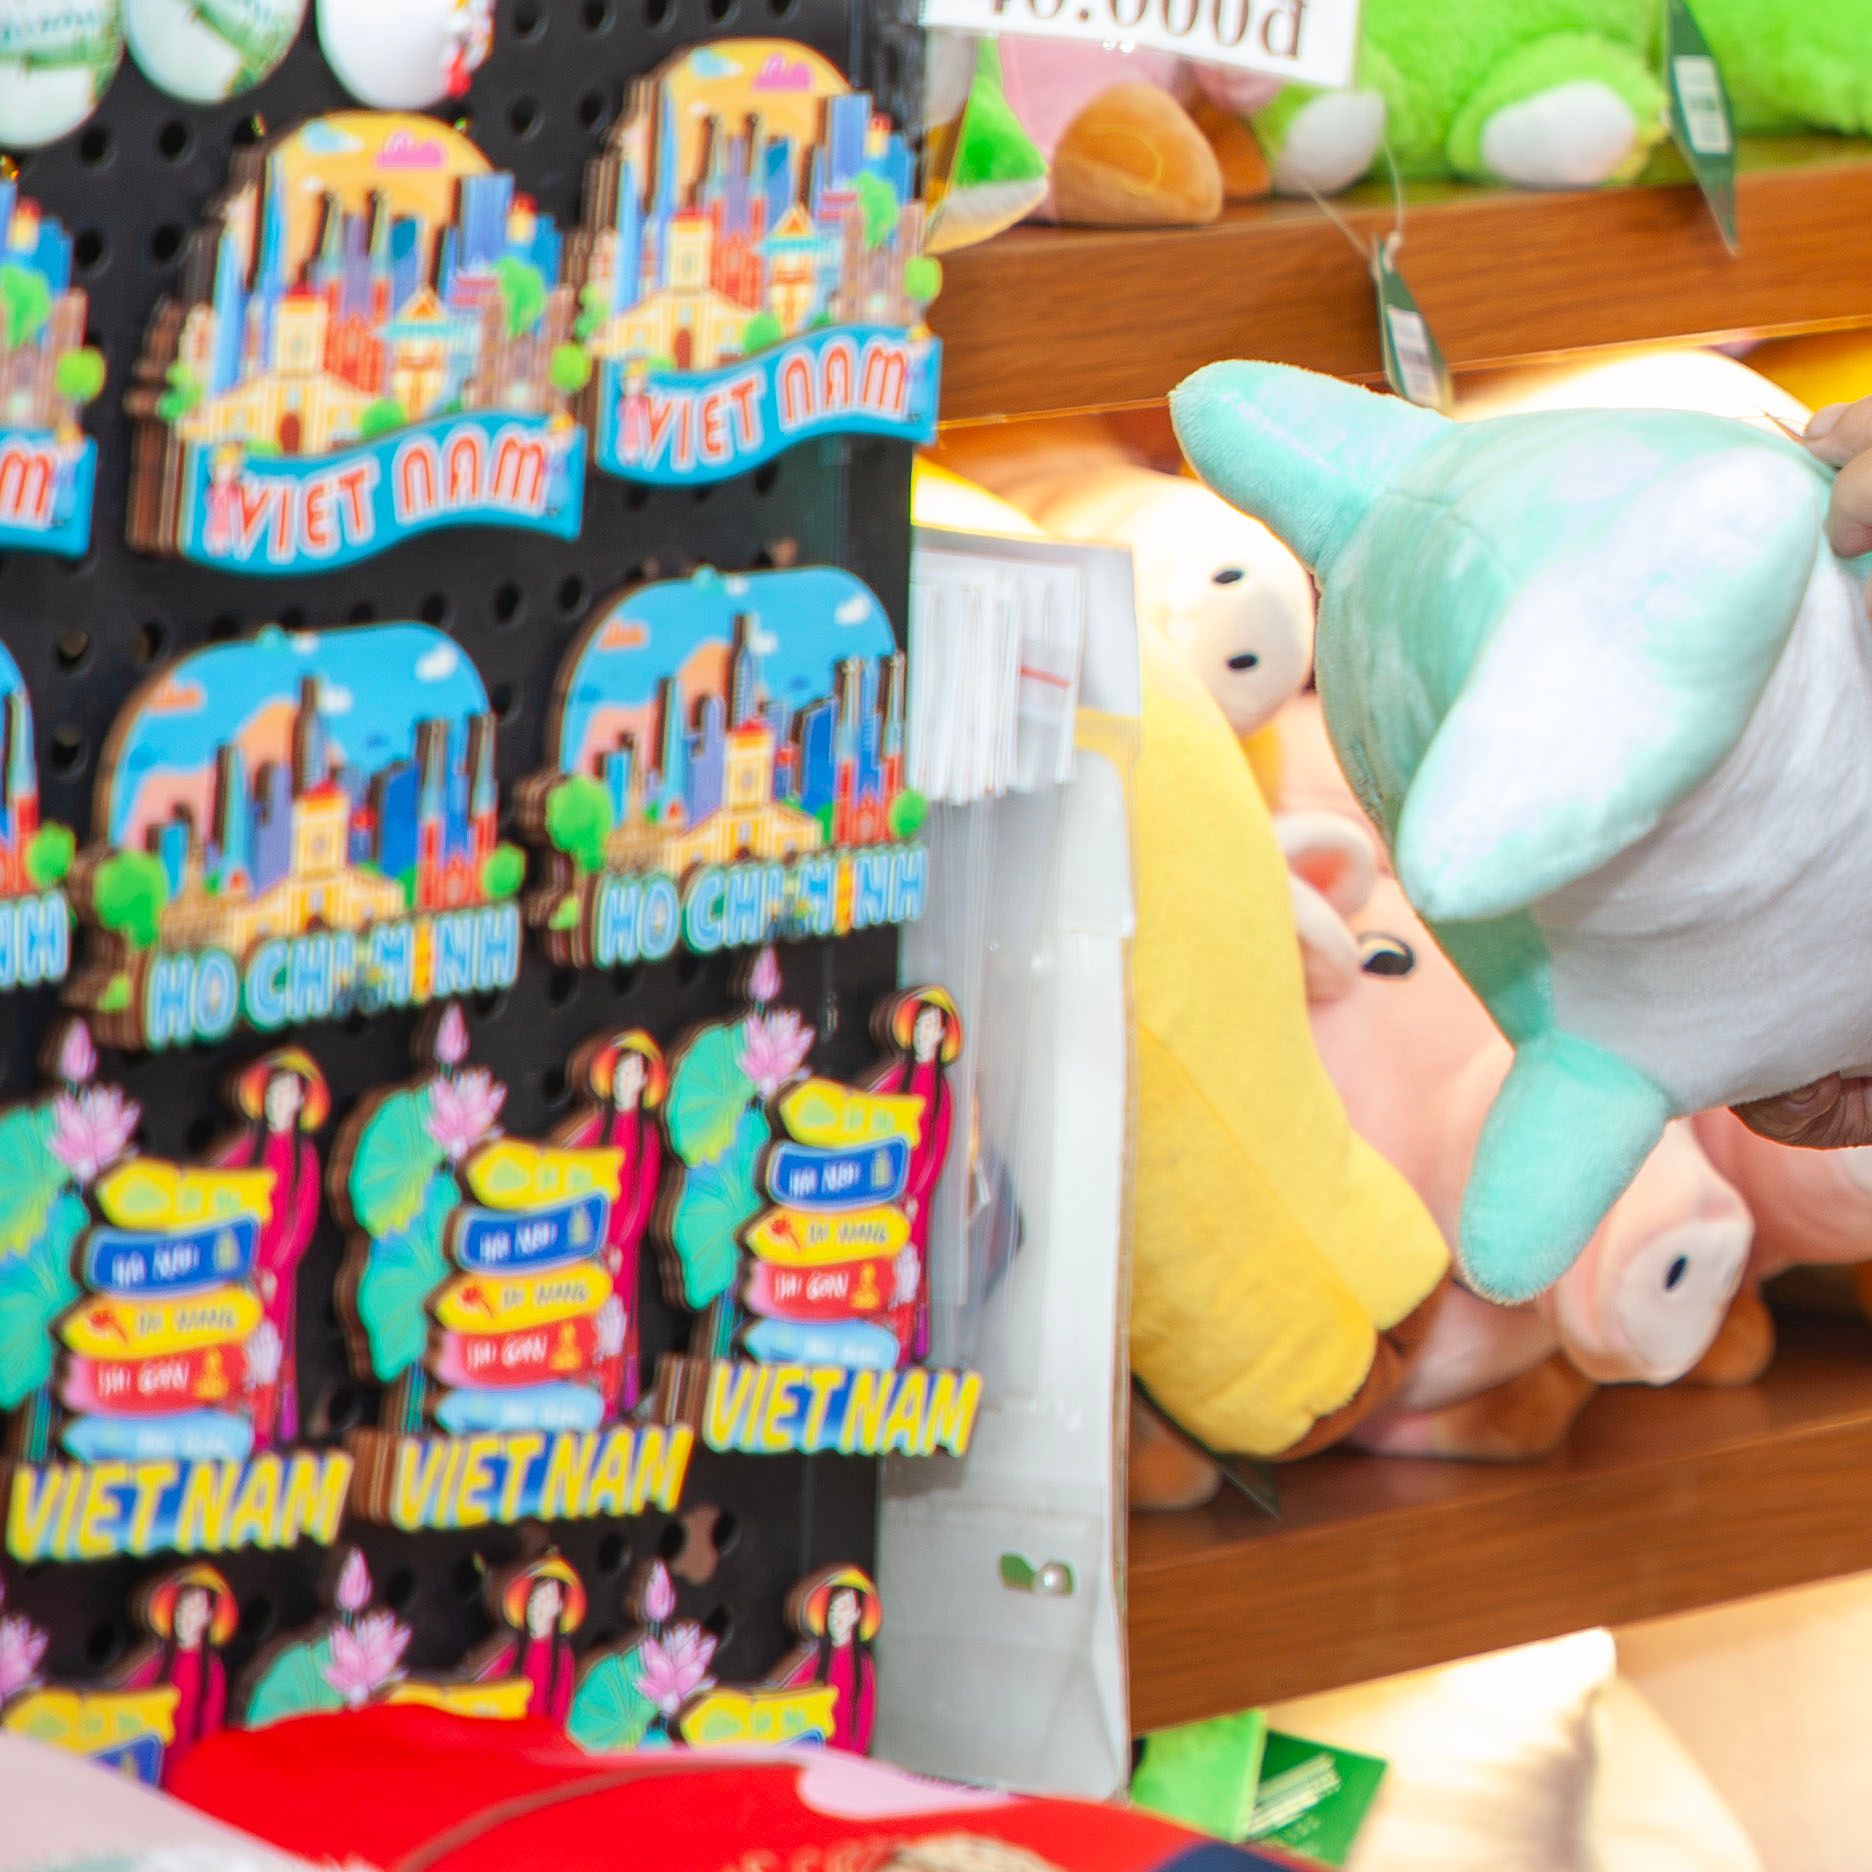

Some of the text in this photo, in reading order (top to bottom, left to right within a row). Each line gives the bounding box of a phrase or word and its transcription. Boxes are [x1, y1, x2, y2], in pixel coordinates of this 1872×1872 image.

[595, 870, 679, 970] HO
[146, 948, 240, 1052] HO
[704, 1360, 982, 1457] VIET NAM
[6, 1449, 355, 1564] VIET NAM
[394, 1424, 693, 1531] VIET NAM
